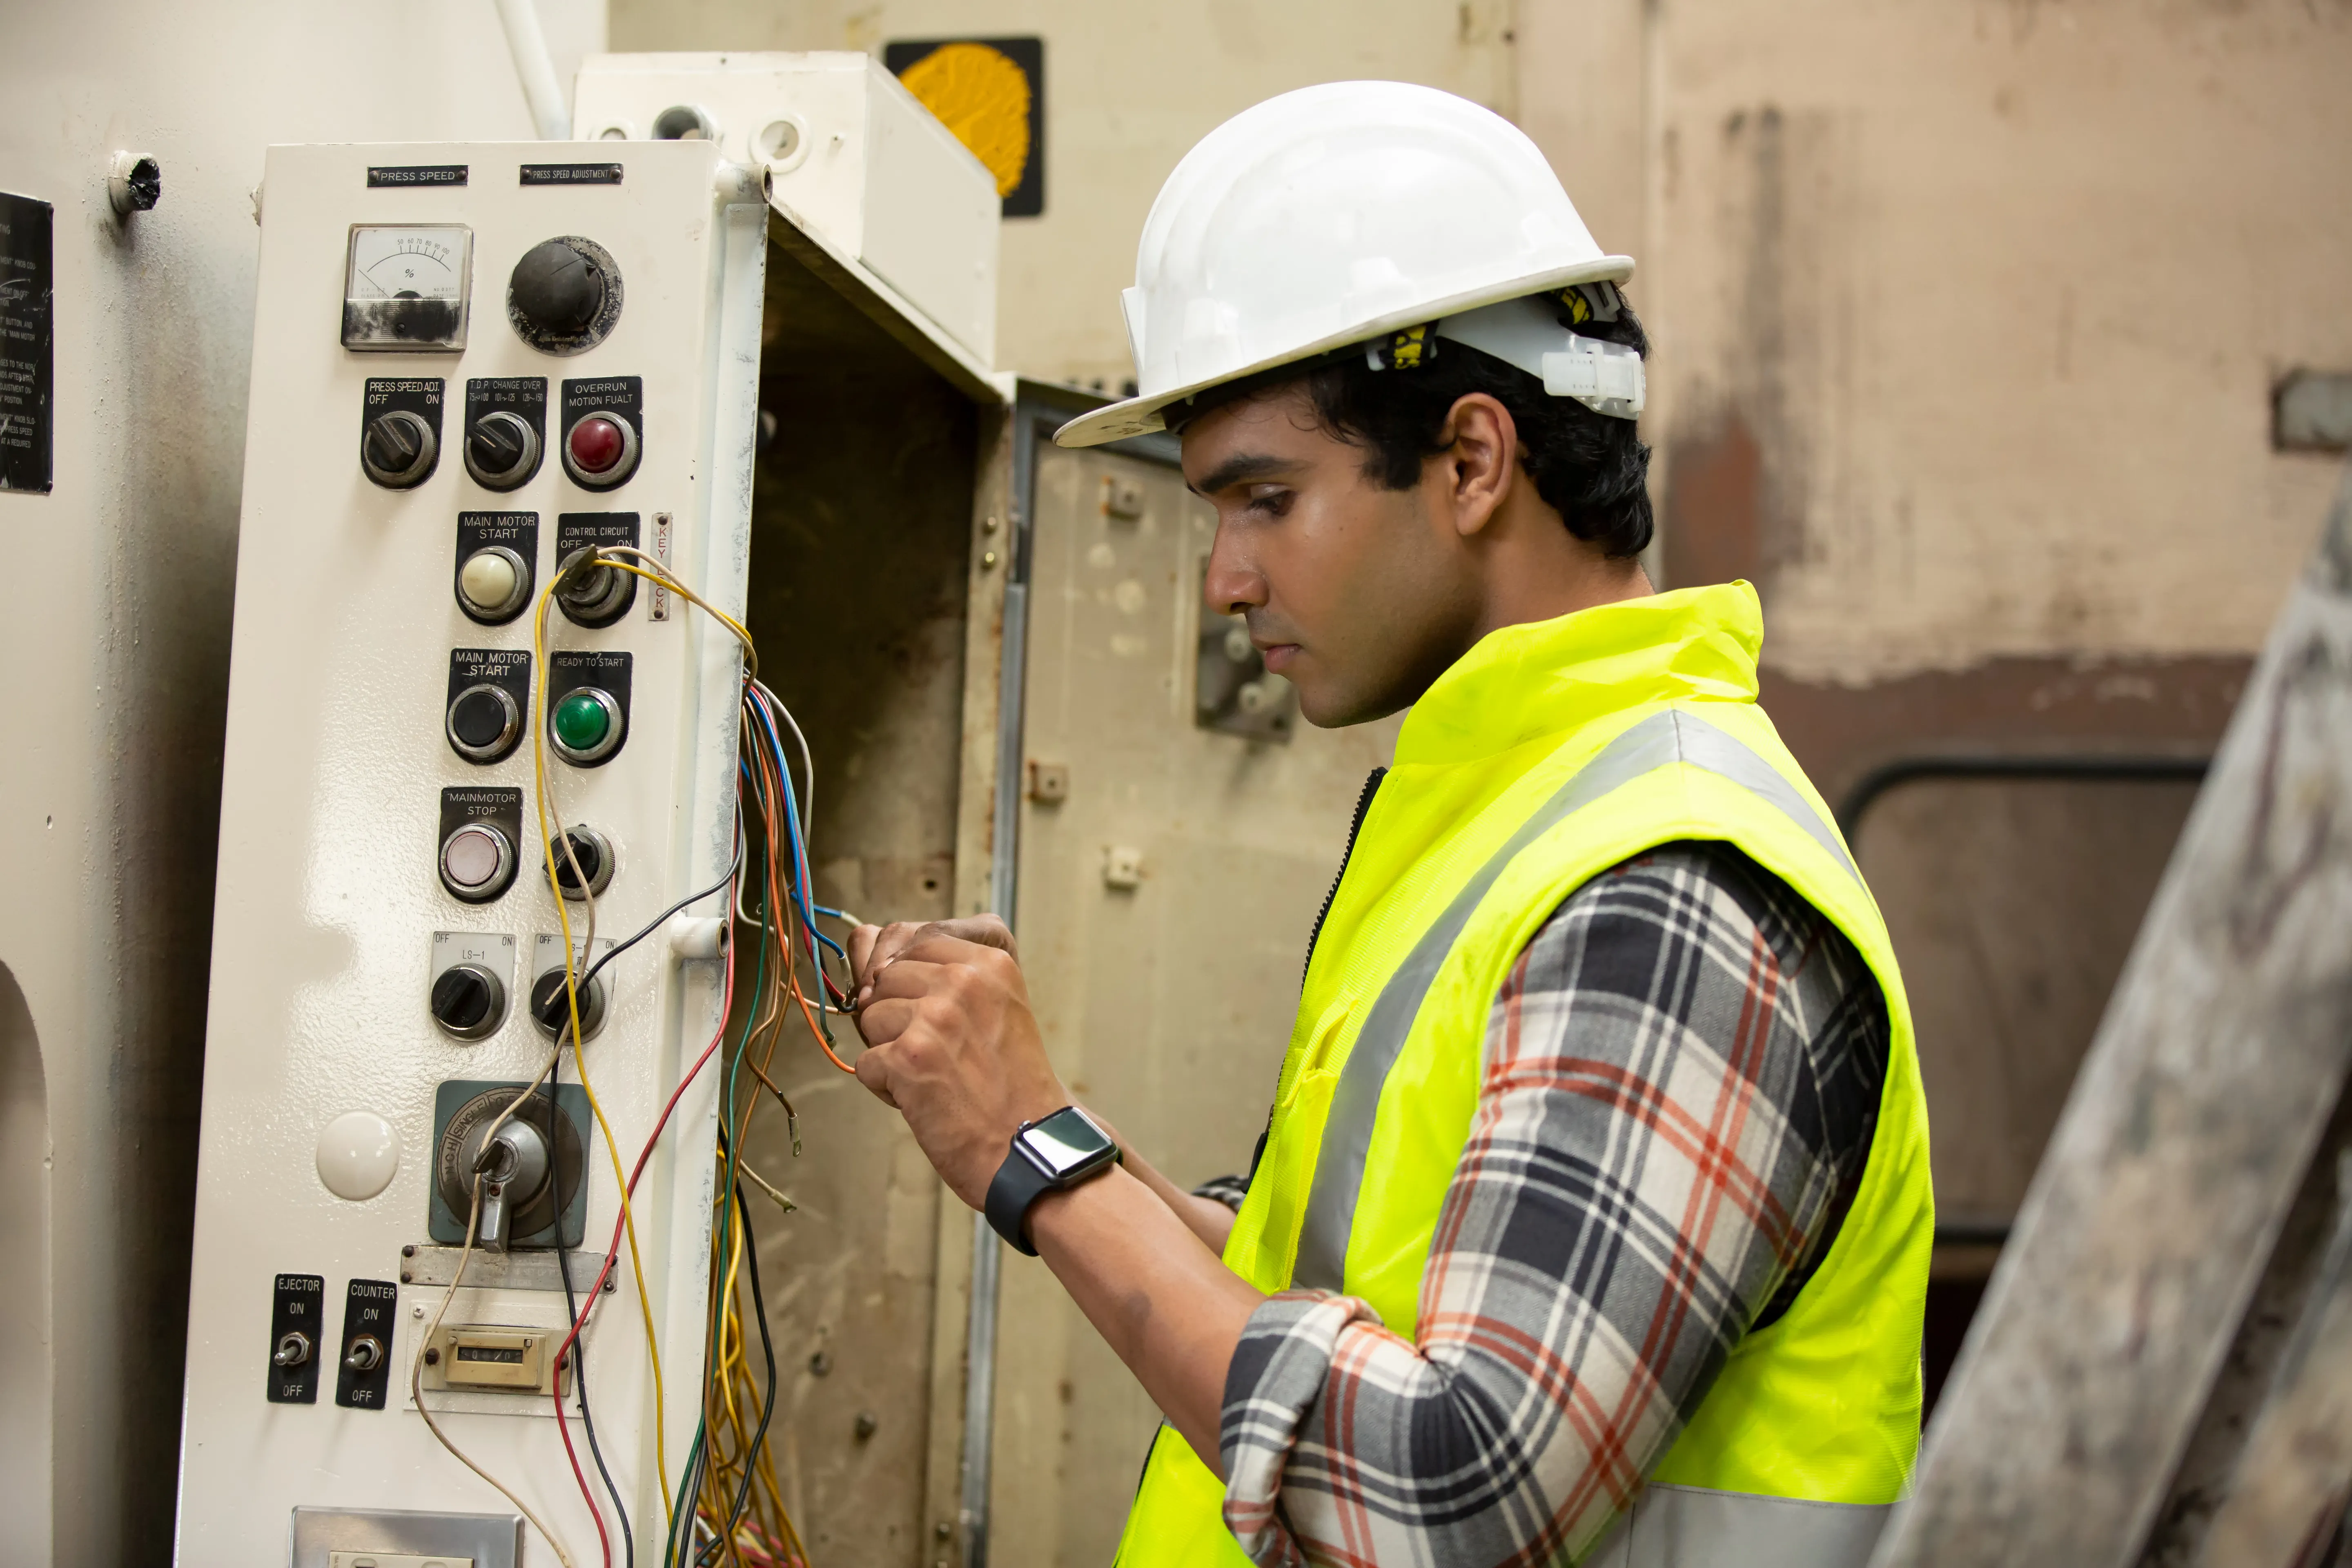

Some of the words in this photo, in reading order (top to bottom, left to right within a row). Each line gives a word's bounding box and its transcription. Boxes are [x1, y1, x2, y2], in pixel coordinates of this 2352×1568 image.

[381, 172, 416, 181] PRESS
[420, 172, 455, 180] SPEED
[533, 170, 550, 179] PRESS
[552, 170, 570, 178] SPEED
[572, 169, 608, 178] ADJUSTMENT
[9, 360, 15, 368] TO
[16, 361, 24, 370] THE
[370, 382, 395, 392] PRESS
[397, 382, 423, 392] SPEED
[423, 382, 439, 392] ADJ.
[493, 381, 520, 389] CHANGE
[523, 381, 541, 389] OVER
[575, 382, 626, 394] OVERRUN
[369, 394, 389, 404] OFF
[426, 394, 439, 404] ON
[569, 396, 602, 407] MOTION
[606, 394, 633, 404] FUALT
[19, 427, 33, 436] SPEED
[465, 516, 491, 526] MAIN
[497, 516, 535, 526] MOTOR
[479, 529, 518, 539] START
[566, 527, 597, 536] CONTROL
[600, 527, 629, 536] CIRCUIT
[561, 540, 582, 548] OFF
[617, 539, 632, 548] ON
[658, 528, 666, 559] KEY
[456, 652, 483, 663] MAIN
[489, 653, 527, 664] MOTOR
[557, 658, 583, 666] READY
[586, 658, 596, 666] TO
[599, 658, 624, 667] START
[470, 665, 510, 676] START
[468, 806, 497, 815] STOP
[436, 933, 450, 943] OFF
[502, 936, 512, 946] ON
[539, 935, 552, 944] OFF
[606, 940, 615, 949] ON
[463, 949, 485, 960] LS-1
[454, 1102, 486, 1138] SINGLE
[278, 1278, 320, 1292] EJECTOR
[351, 1285, 395, 1299] COUNTER
[290, 1303, 304, 1314] ON
[364, 1308, 379, 1320] ON
[283, 1385, 303, 1396] OFF
[352, 1390, 373, 1402] OFF
